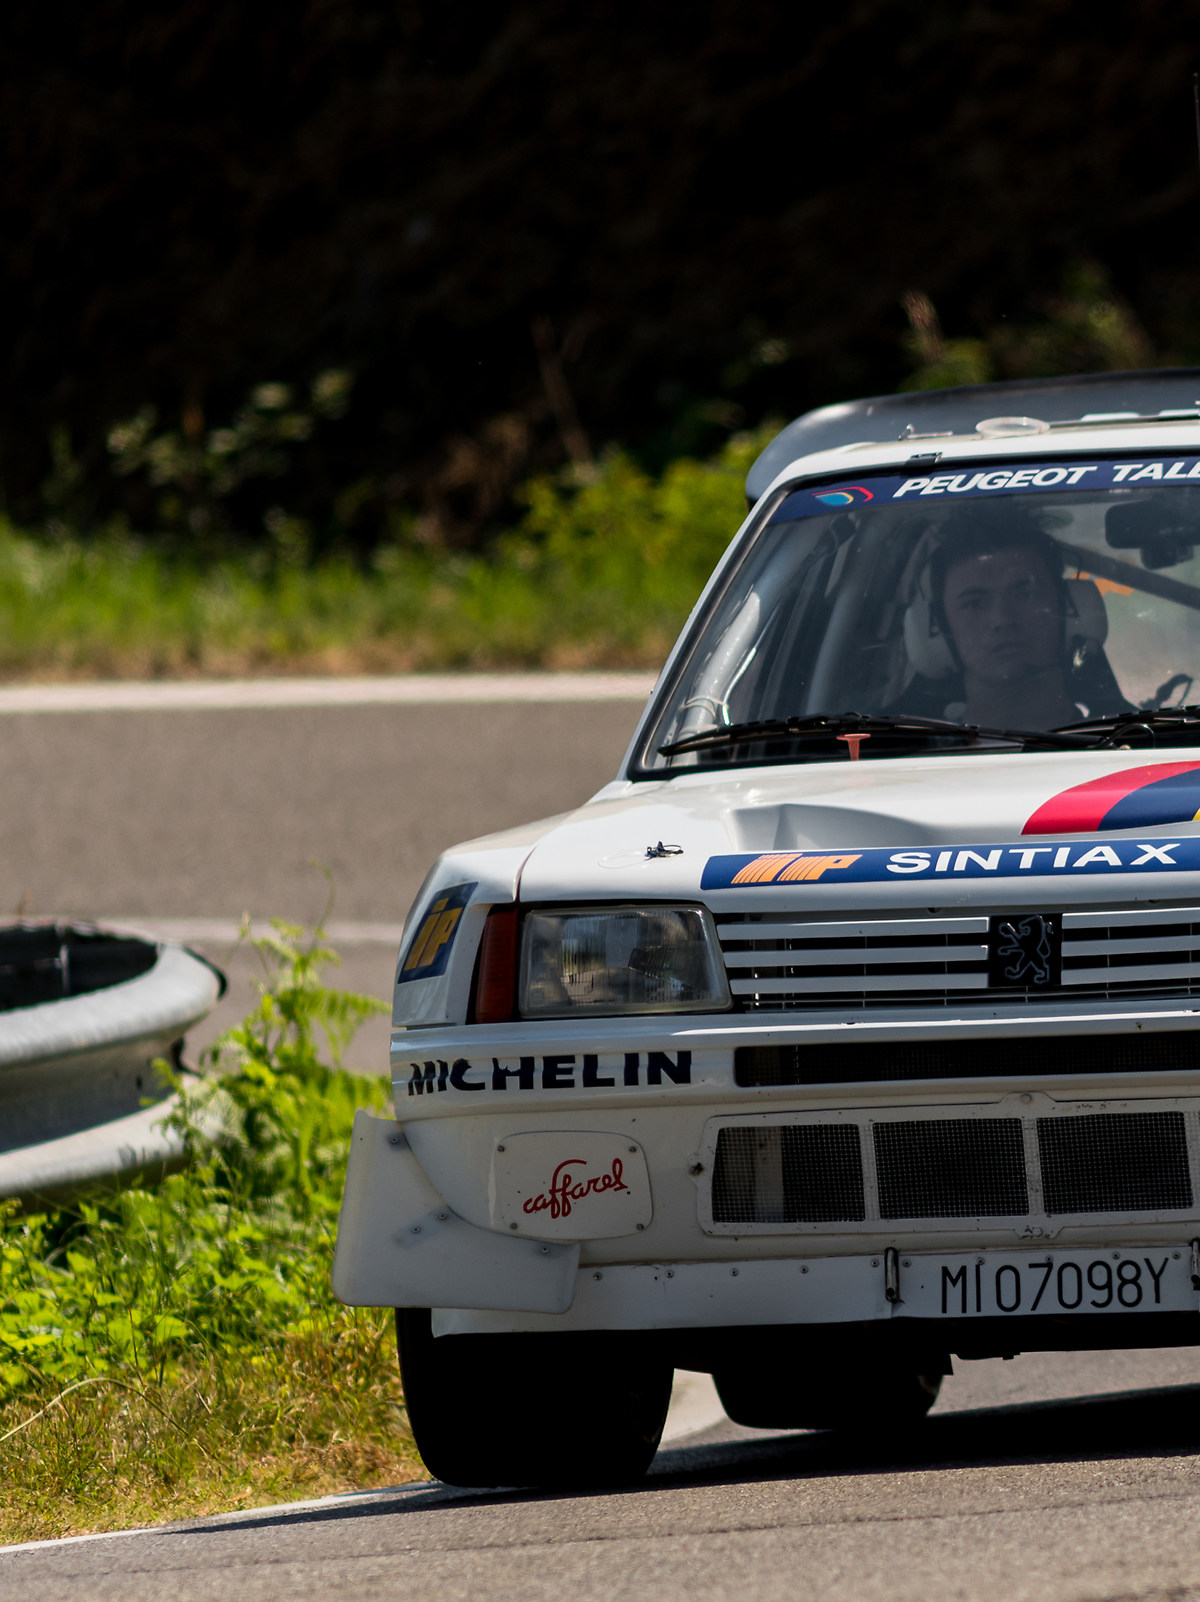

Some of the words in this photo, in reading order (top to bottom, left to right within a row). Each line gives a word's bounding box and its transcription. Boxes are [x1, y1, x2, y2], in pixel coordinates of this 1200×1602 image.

[892, 465, 1098, 498] PEUGEOT
[886, 843, 1181, 874] SINTIAX
[407, 1050, 692, 1097] MICHELIN
